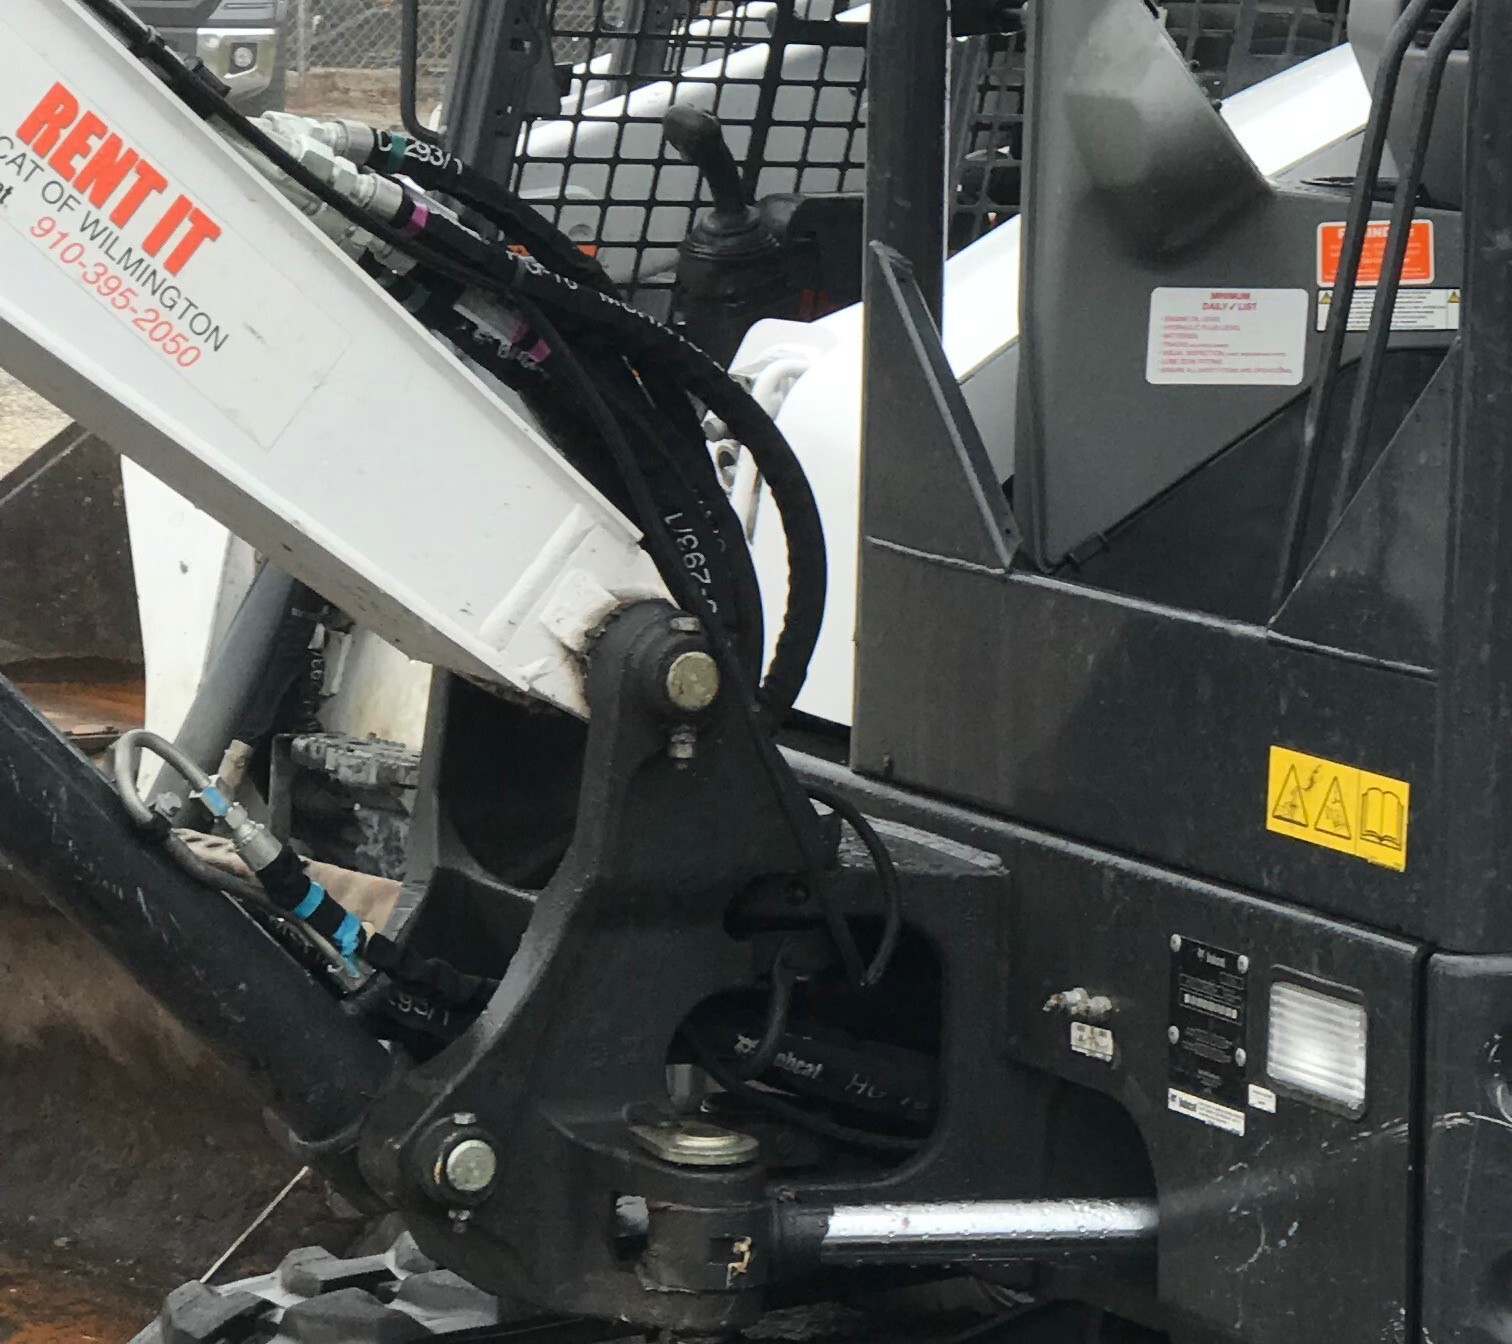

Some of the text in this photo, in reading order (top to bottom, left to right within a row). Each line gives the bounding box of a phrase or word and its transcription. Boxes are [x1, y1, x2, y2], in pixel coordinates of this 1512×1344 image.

[16, 80, 223, 276] RENT IT
[30, 216, 202, 369] 910-395-2050
[41, 180, 82, 212] OF
[79, 209, 231, 353] WILMINGTON
